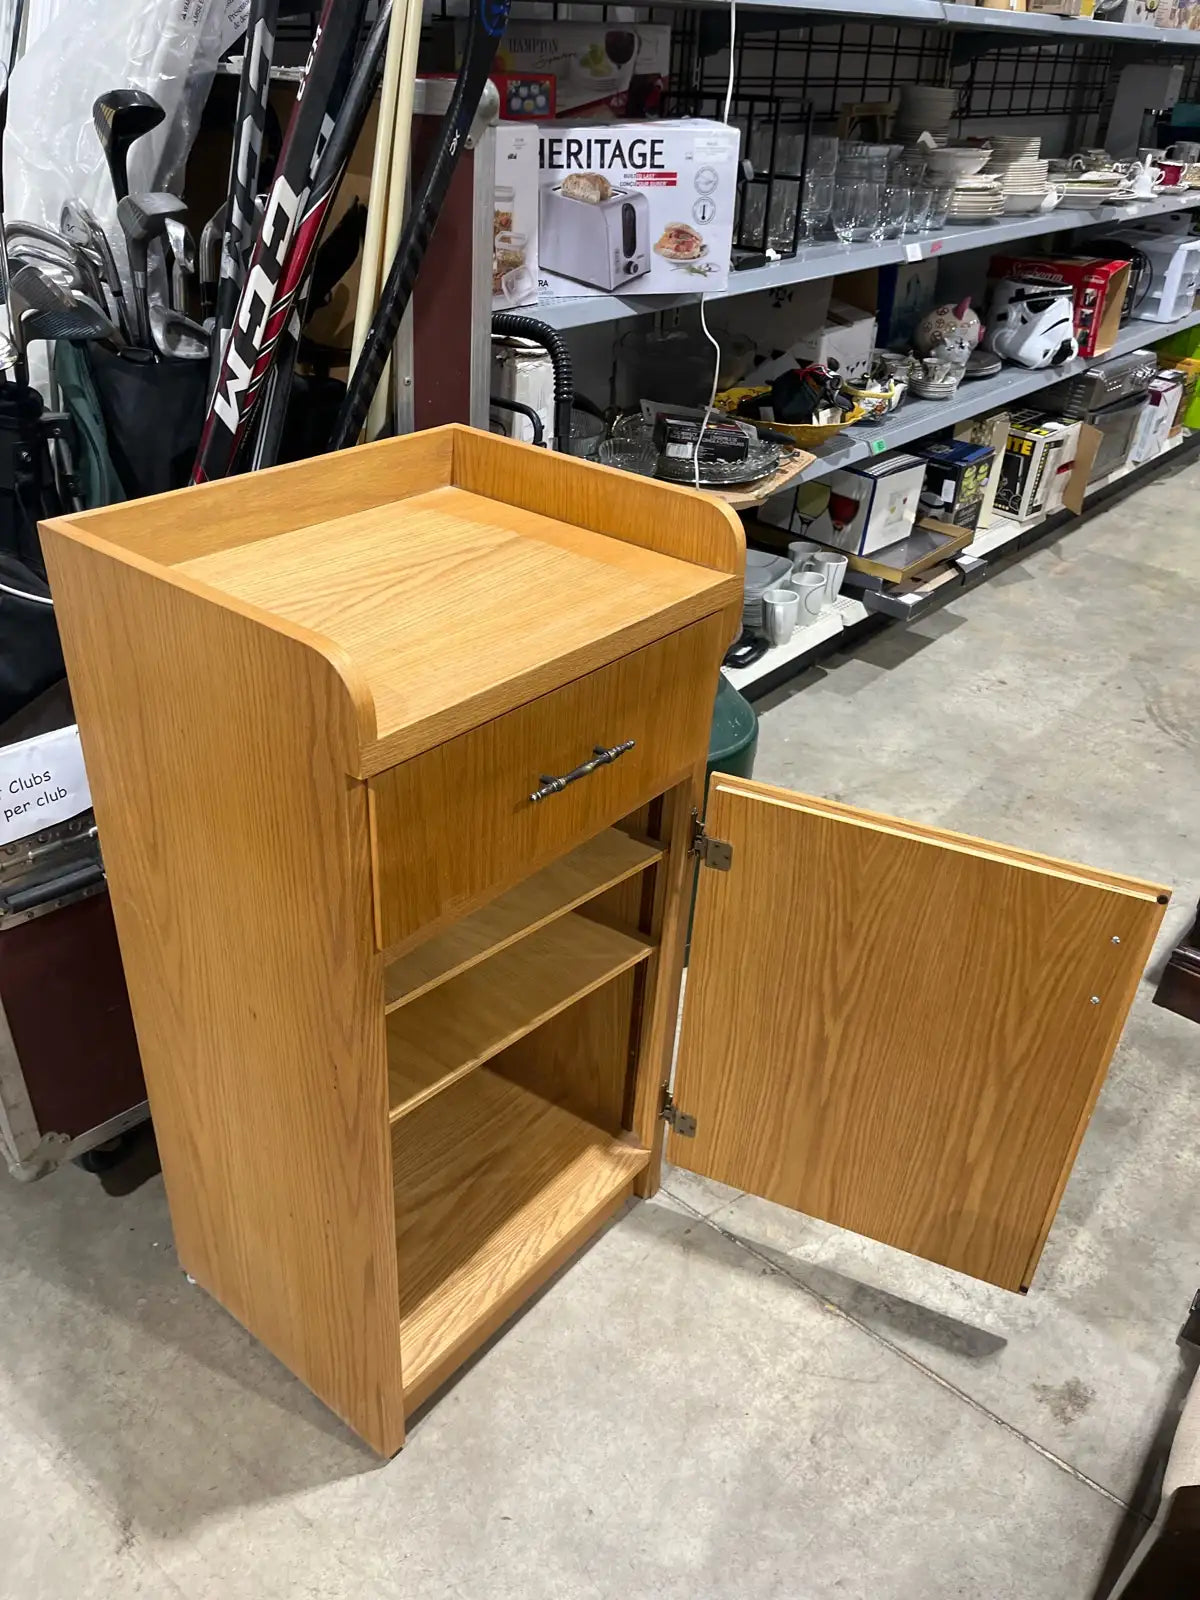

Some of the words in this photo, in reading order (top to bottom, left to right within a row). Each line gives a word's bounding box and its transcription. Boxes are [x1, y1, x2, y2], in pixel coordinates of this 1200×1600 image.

[296, 24, 322, 101] CCM
[537, 279, 549, 287] RA
[213, 174, 300, 435] CCM
[9, 770, 51, 794] Clubs
[3, 801, 31, 823] per
[36, 786, 67, 807] club
